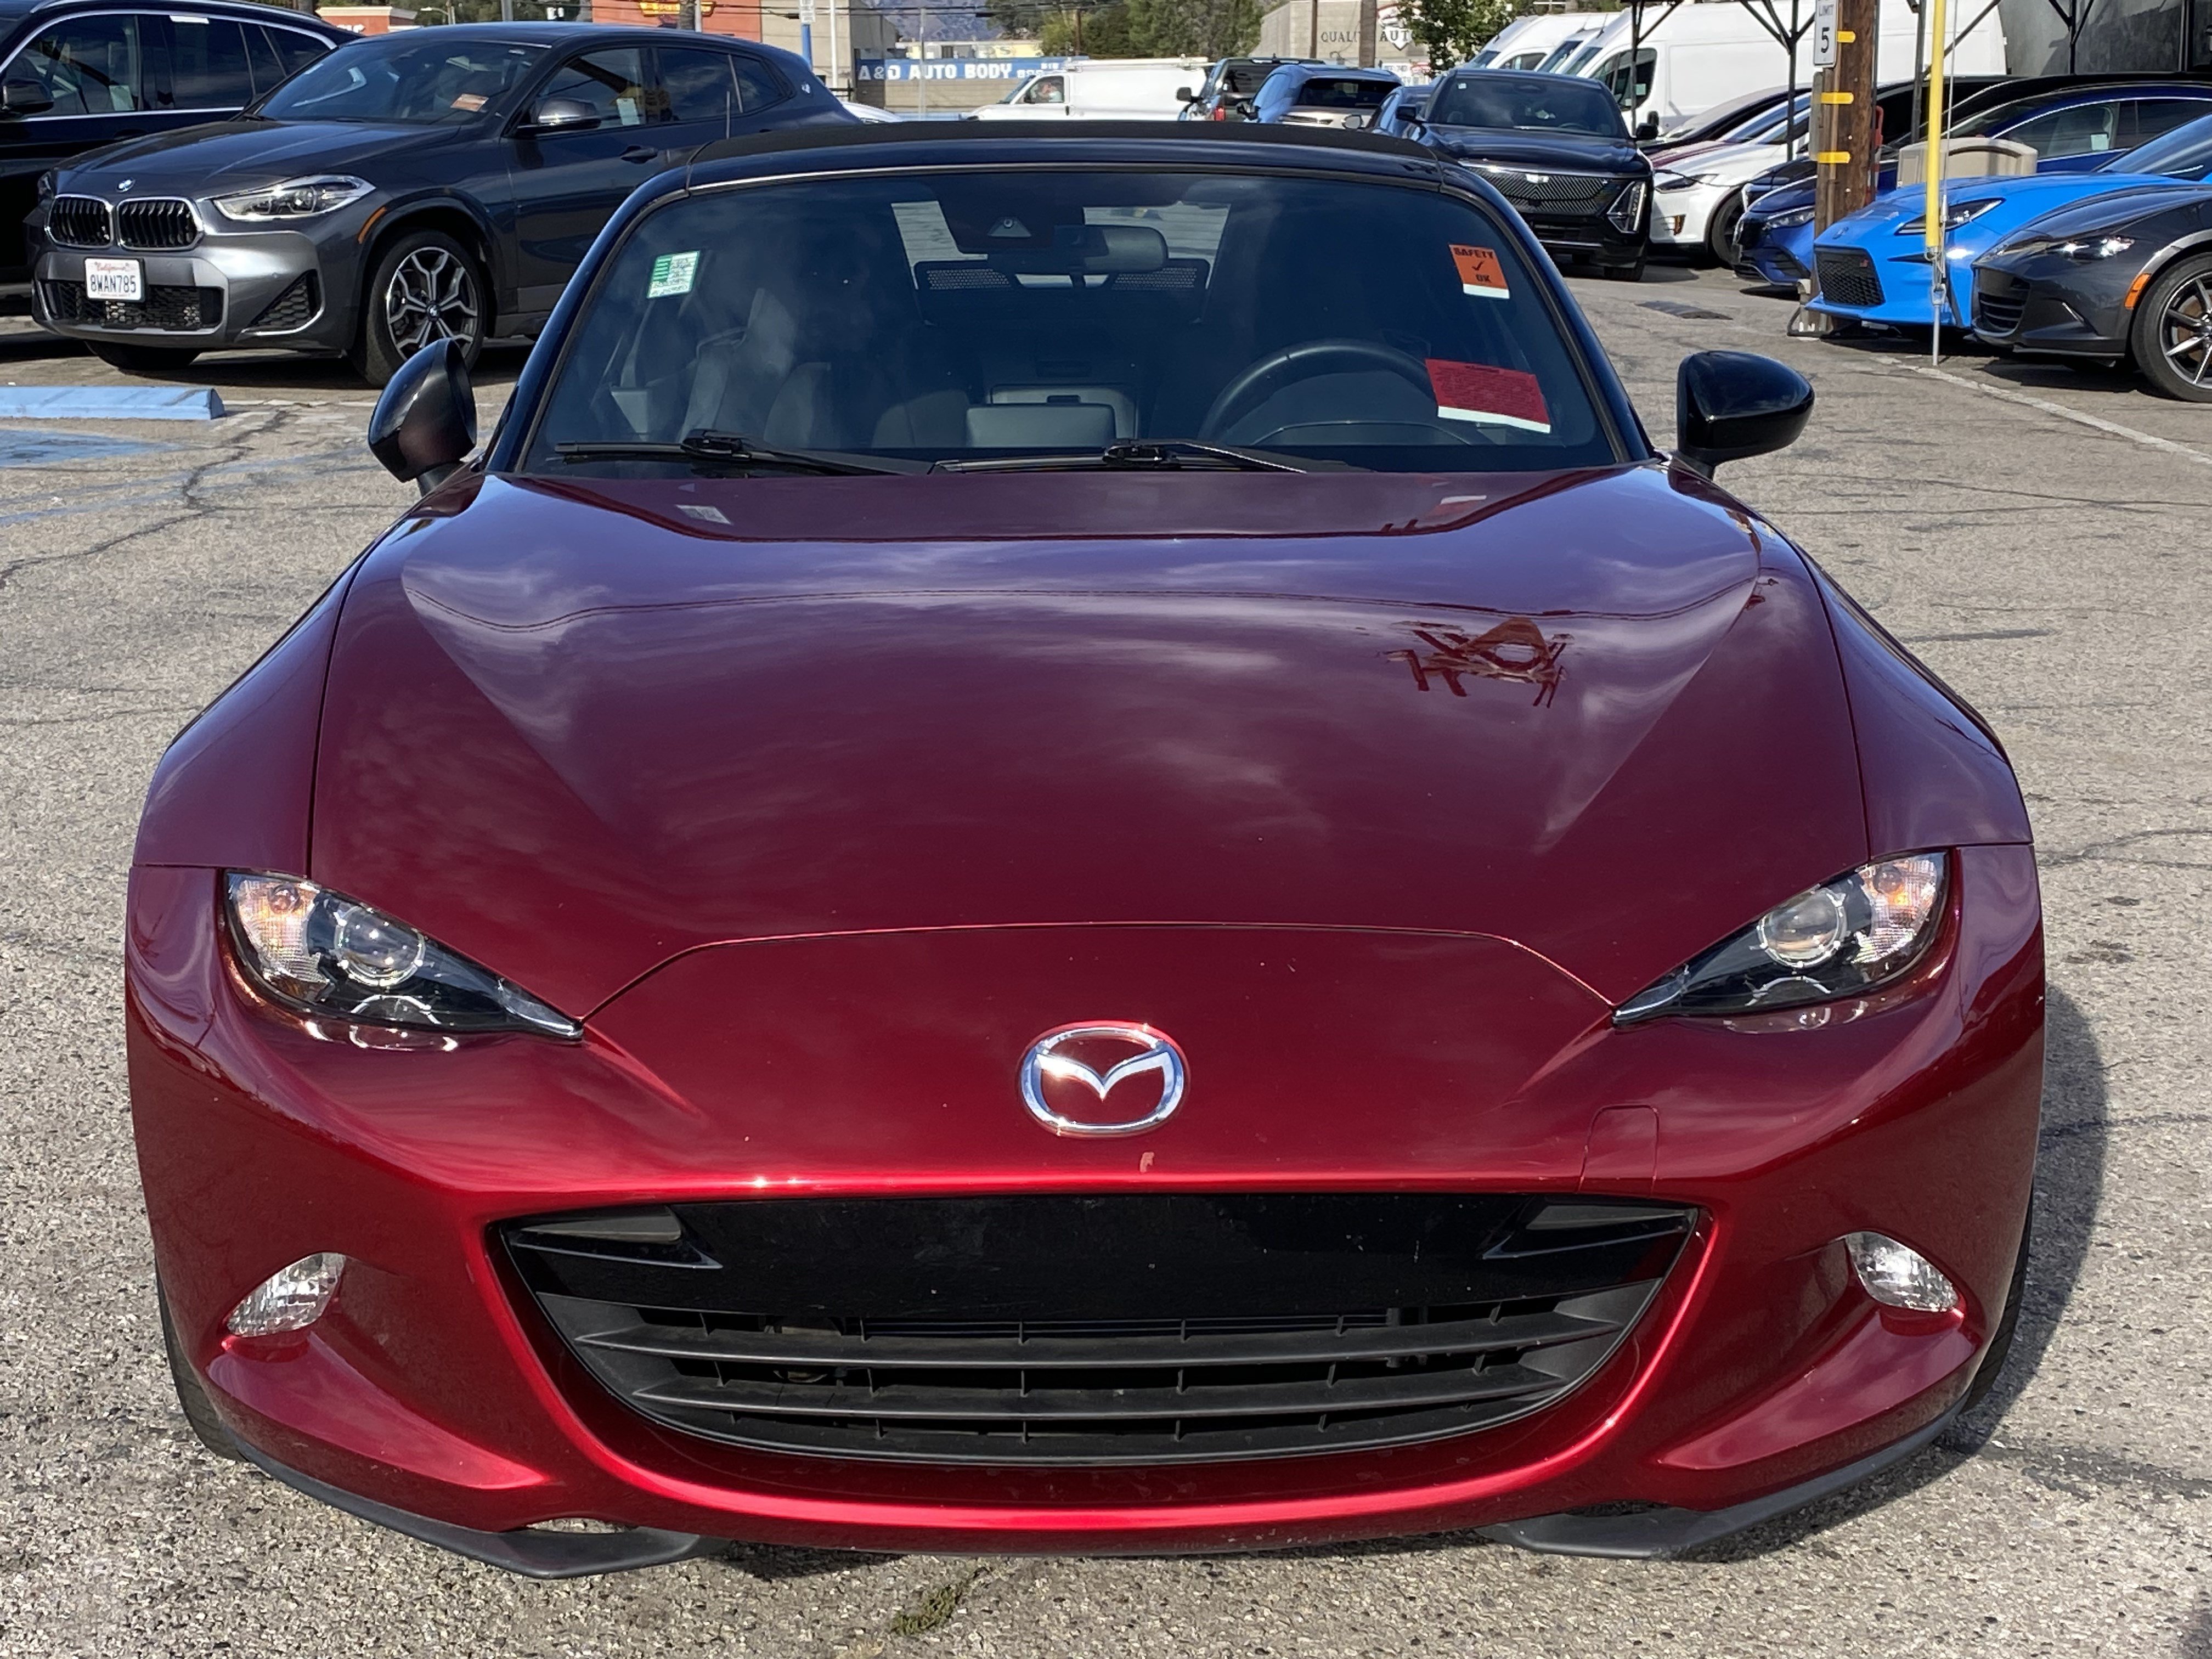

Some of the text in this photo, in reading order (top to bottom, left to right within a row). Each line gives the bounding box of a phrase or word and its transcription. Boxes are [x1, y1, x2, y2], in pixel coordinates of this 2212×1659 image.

[1821, 27, 1830, 53] 5
[908, 64, 957, 80] AUTO
[964, 63, 1012, 79] BODY
[1453, 247, 1494, 259] SAFETY
[89, 274, 137, 294] 8WAN785
[1475, 274, 1492, 283] OK
